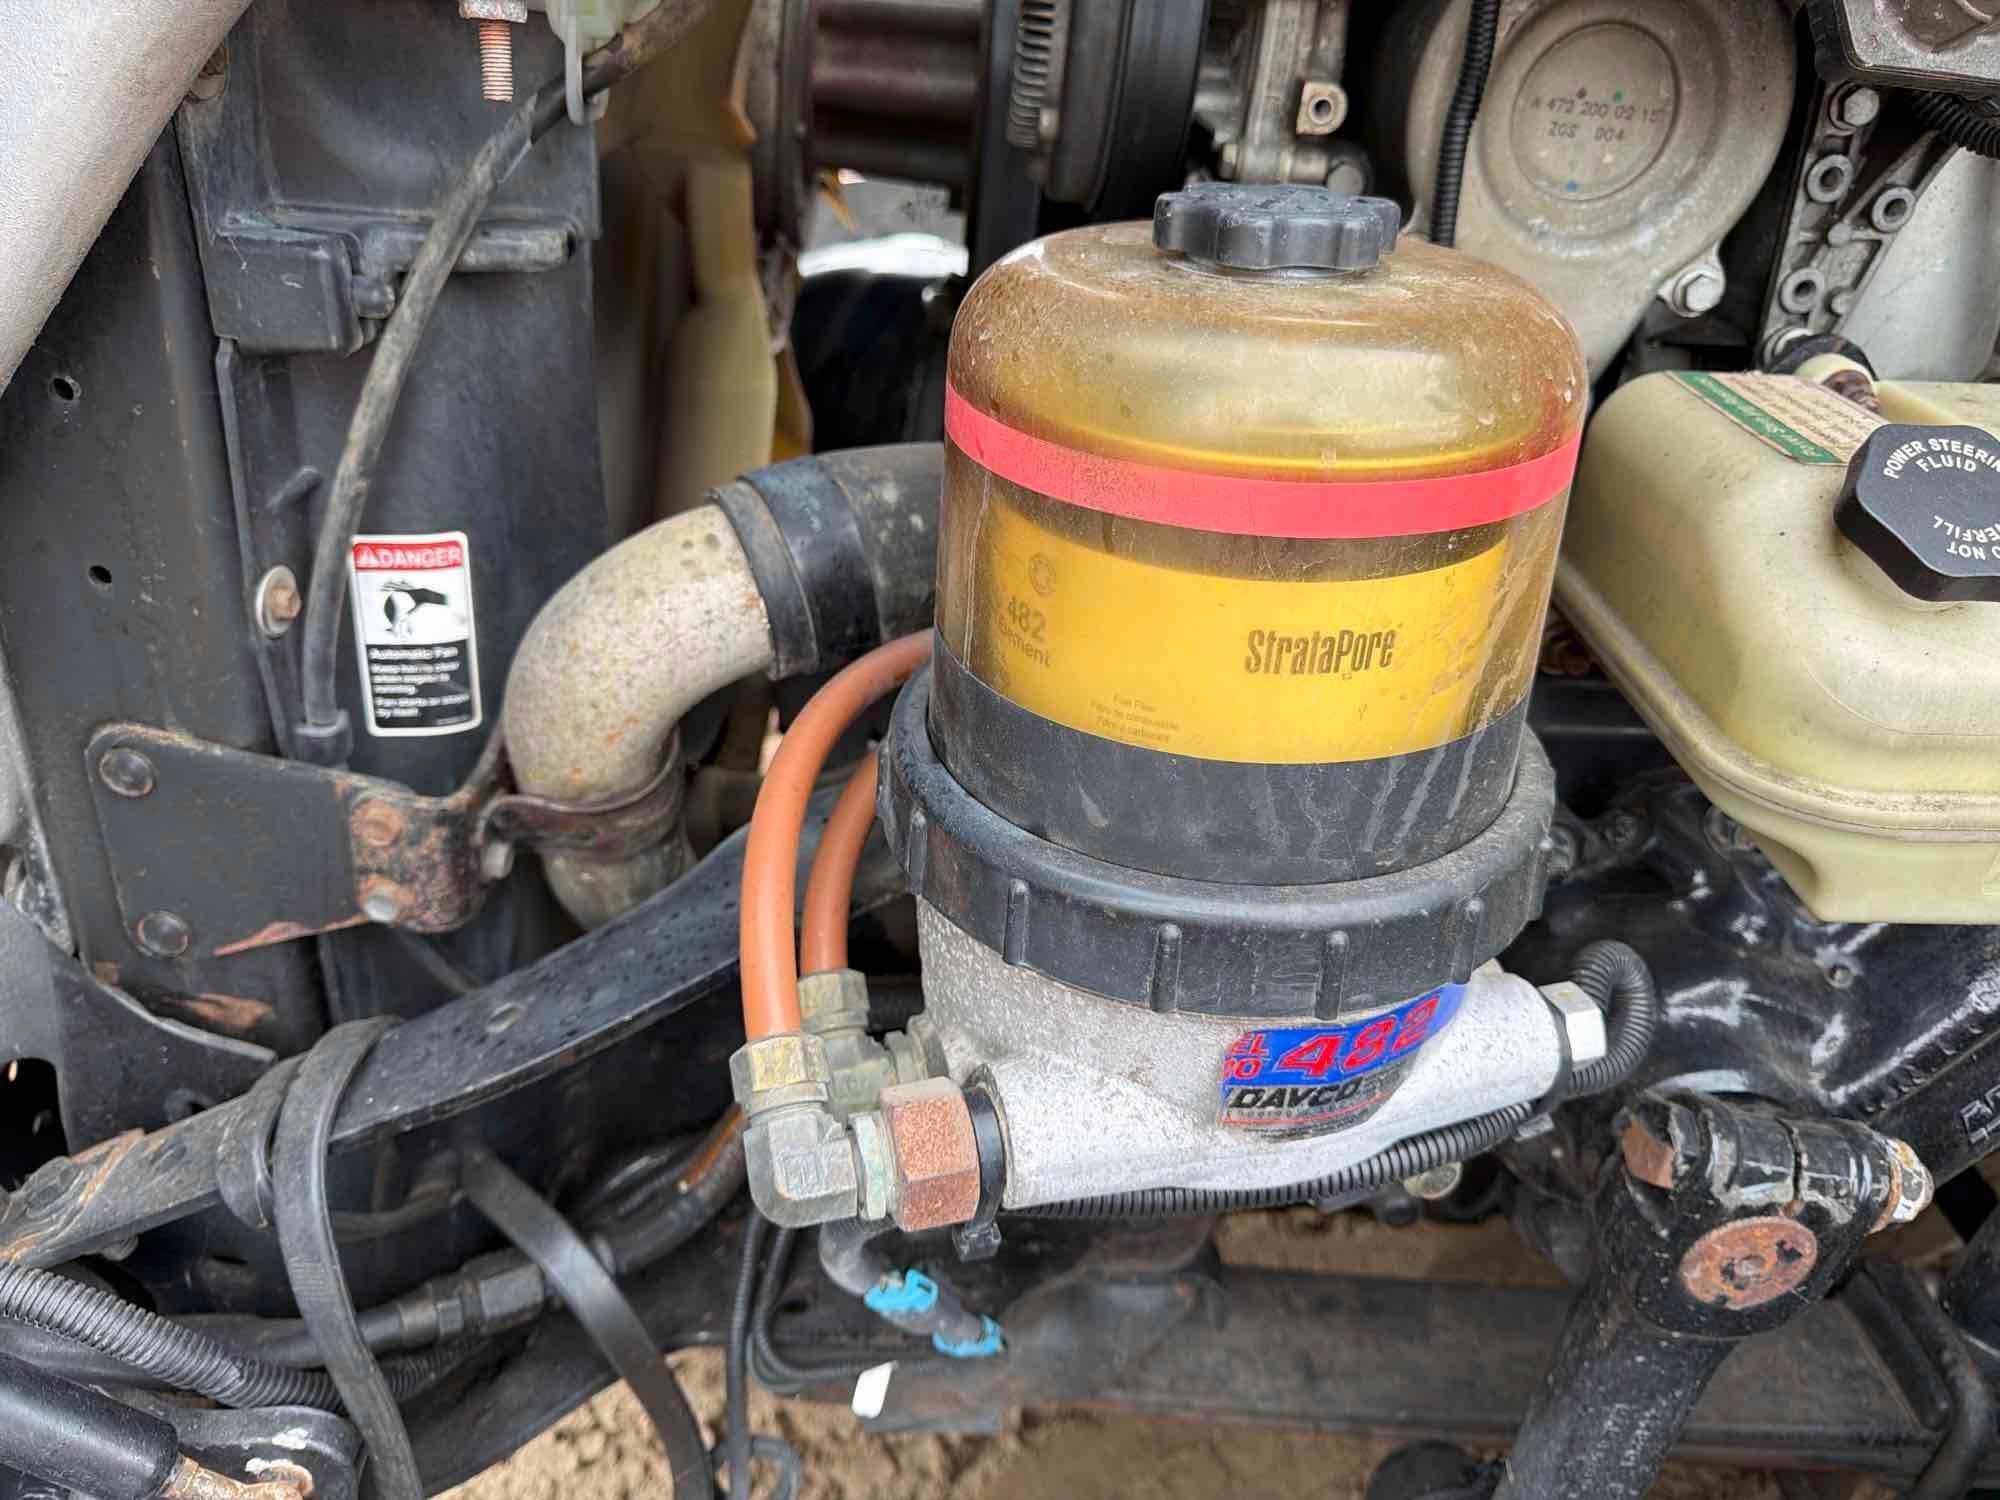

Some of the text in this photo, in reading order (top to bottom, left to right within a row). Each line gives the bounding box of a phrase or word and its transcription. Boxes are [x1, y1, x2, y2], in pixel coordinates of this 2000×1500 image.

[1882, 437, 2000, 480] POWER STEERIN
[1915, 454, 1977, 473] FLUID
[1933, 514, 2000, 543] ERFILL
[378, 546, 462, 568] DANGER
[1946, 541, 1987, 561] NOT
[1008, 595, 1047, 643] 482
[1245, 629, 1397, 675] StrataPore
[1228, 1032, 1270, 1056] EL
[1275, 994, 1441, 1079] 482
[1228, 1077, 1366, 1109] DAVCO
